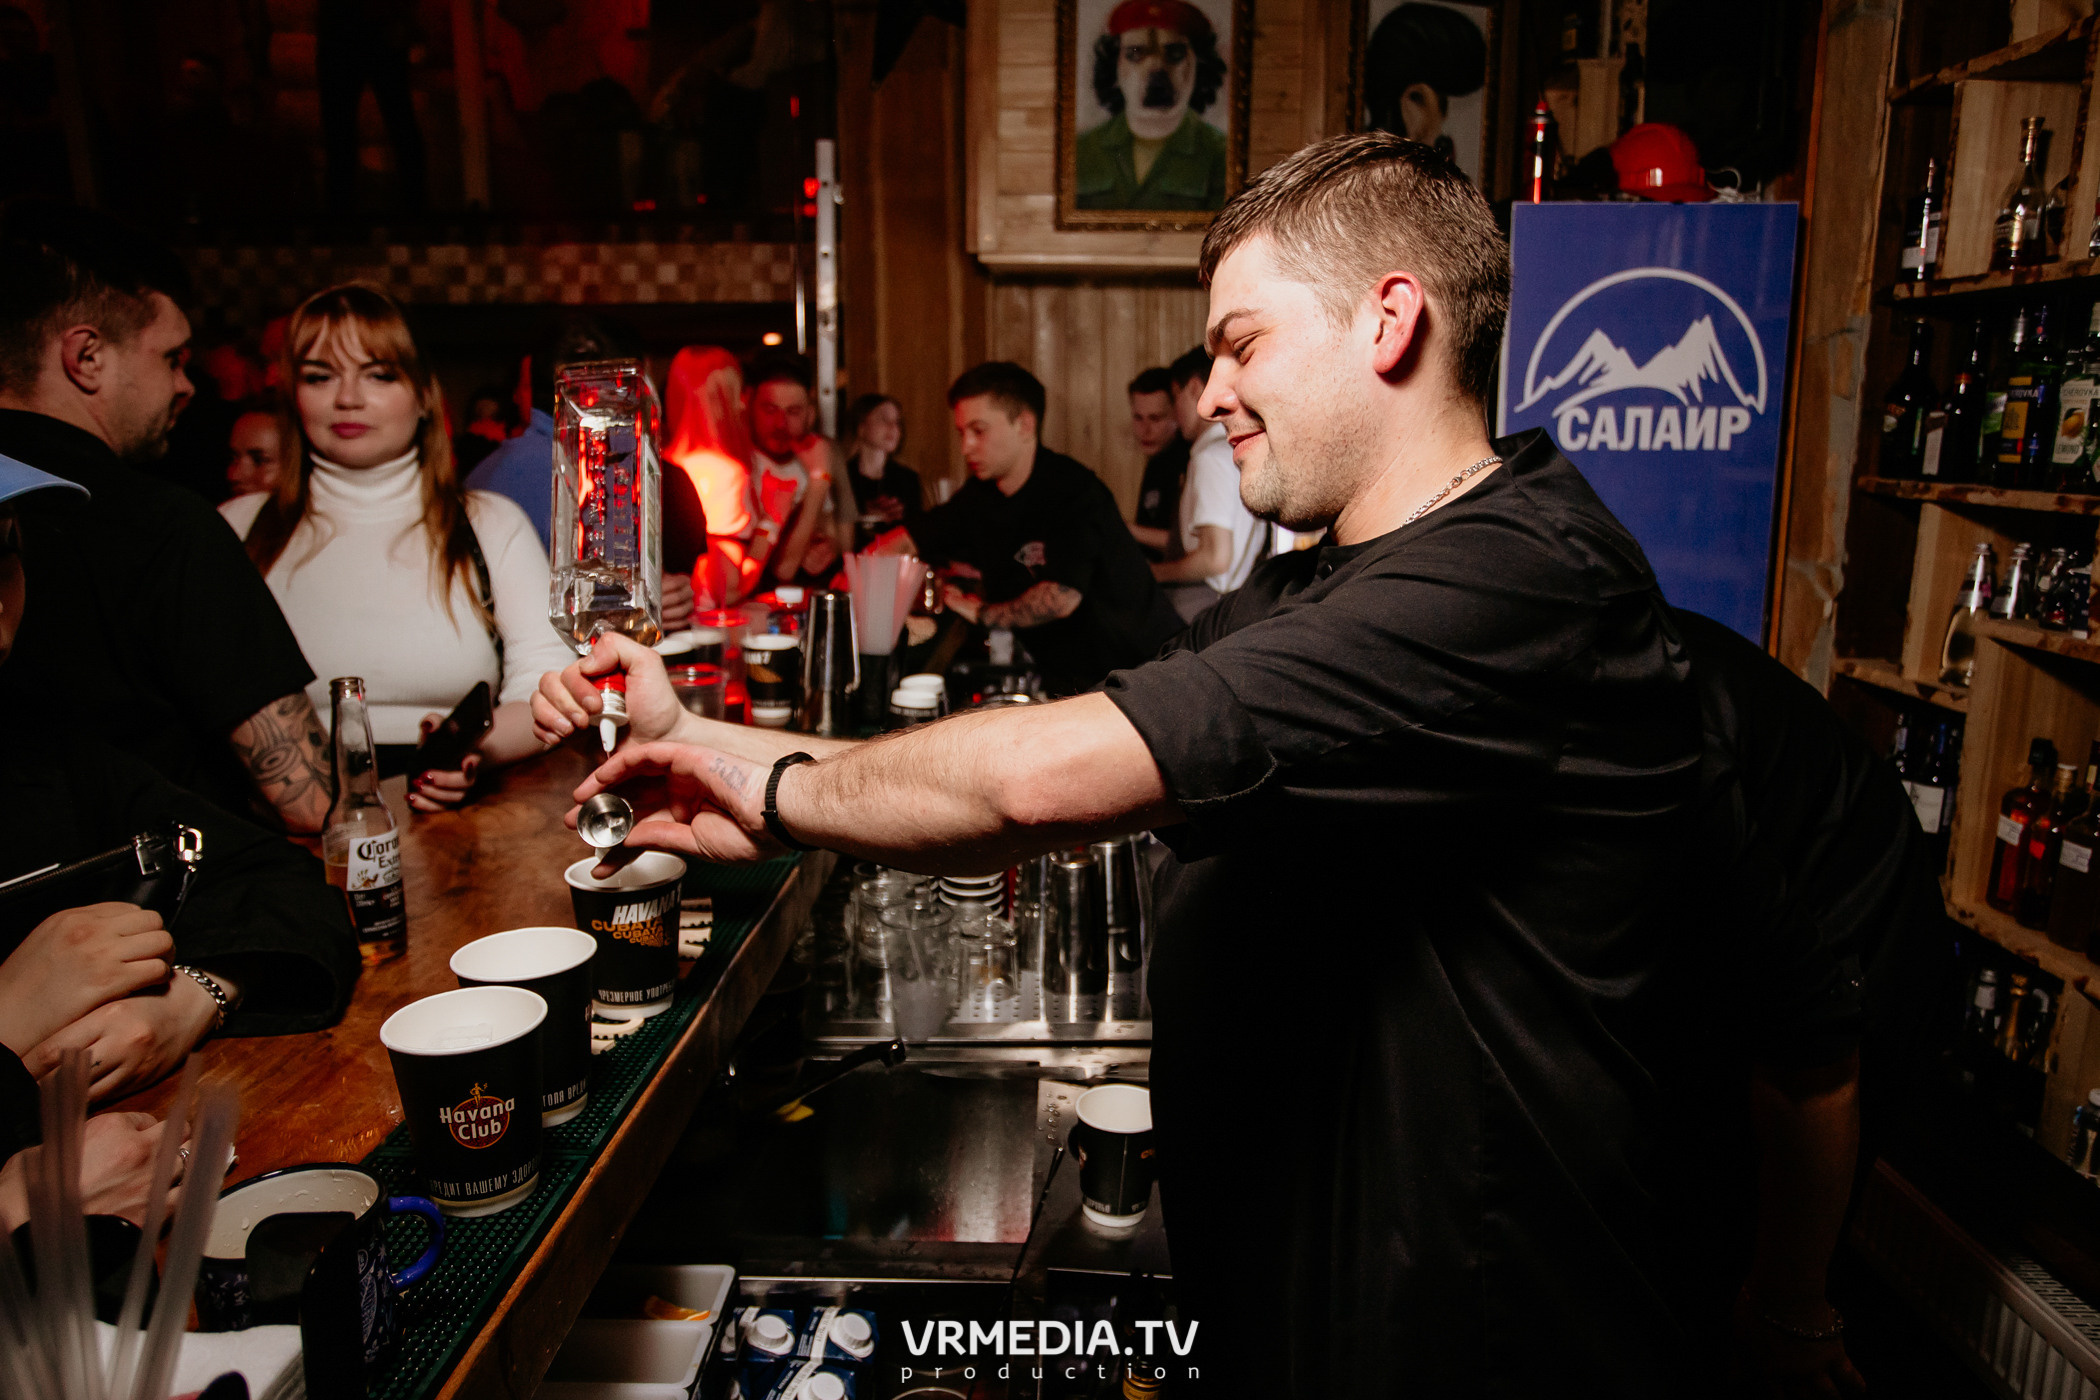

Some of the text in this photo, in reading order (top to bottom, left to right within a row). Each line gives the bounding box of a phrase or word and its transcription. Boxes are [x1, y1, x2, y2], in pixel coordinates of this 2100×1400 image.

[1557, 405, 1751, 451] САЛАИР
[542, 1089, 565, 1107] ГОЛЯ
[439, 1097, 515, 1125] Havana
[458, 1119, 502, 1141] Club
[464, 1173, 508, 1196] ВАШЕМУ
